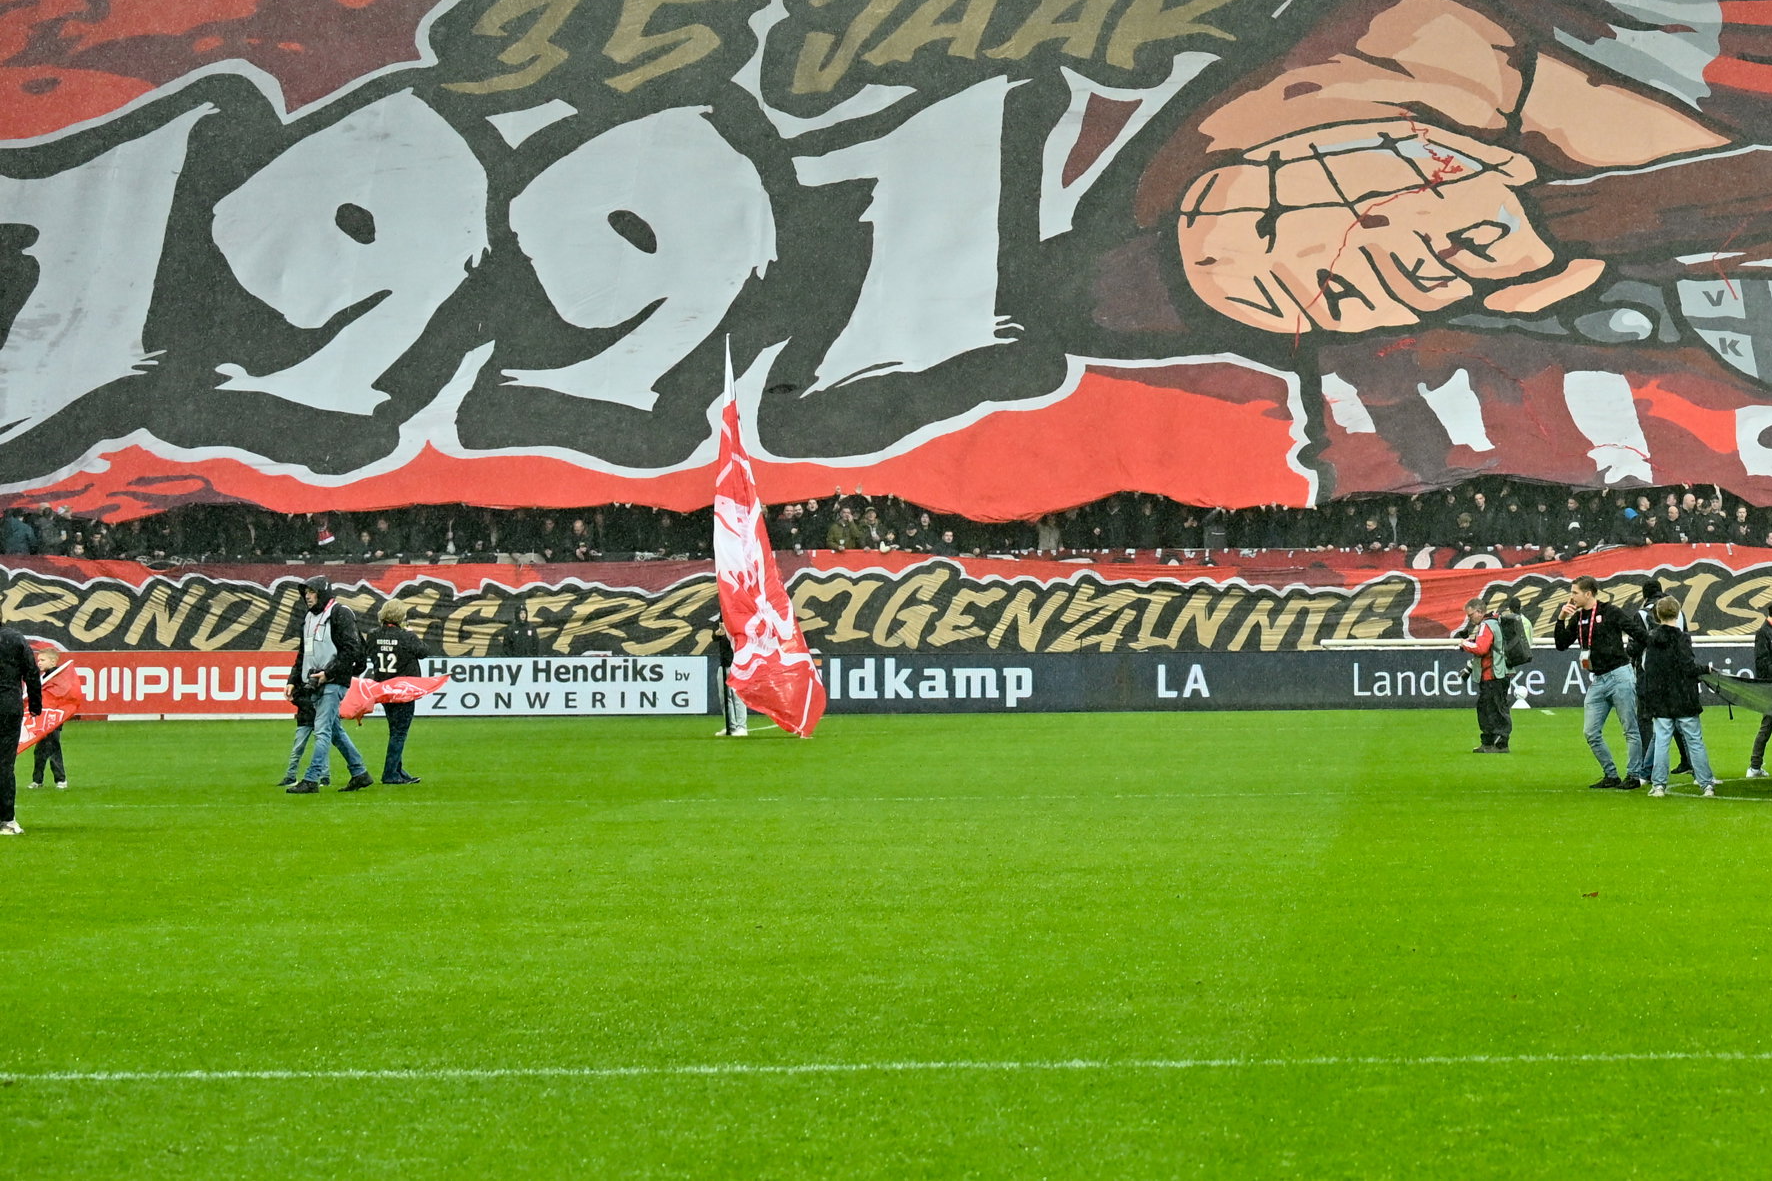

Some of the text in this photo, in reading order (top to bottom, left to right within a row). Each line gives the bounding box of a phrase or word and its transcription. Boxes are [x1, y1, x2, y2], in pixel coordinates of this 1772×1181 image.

[0, 76, 1026, 433] 1991
[376, 652, 398, 674] 12
[428, 658, 691, 686] Henny Hendriks bv
[74, 666, 296, 702] AMPHUIS
[1157, 664, 1211, 698] LA
[431, 690, 690, 710] ZONWERING
